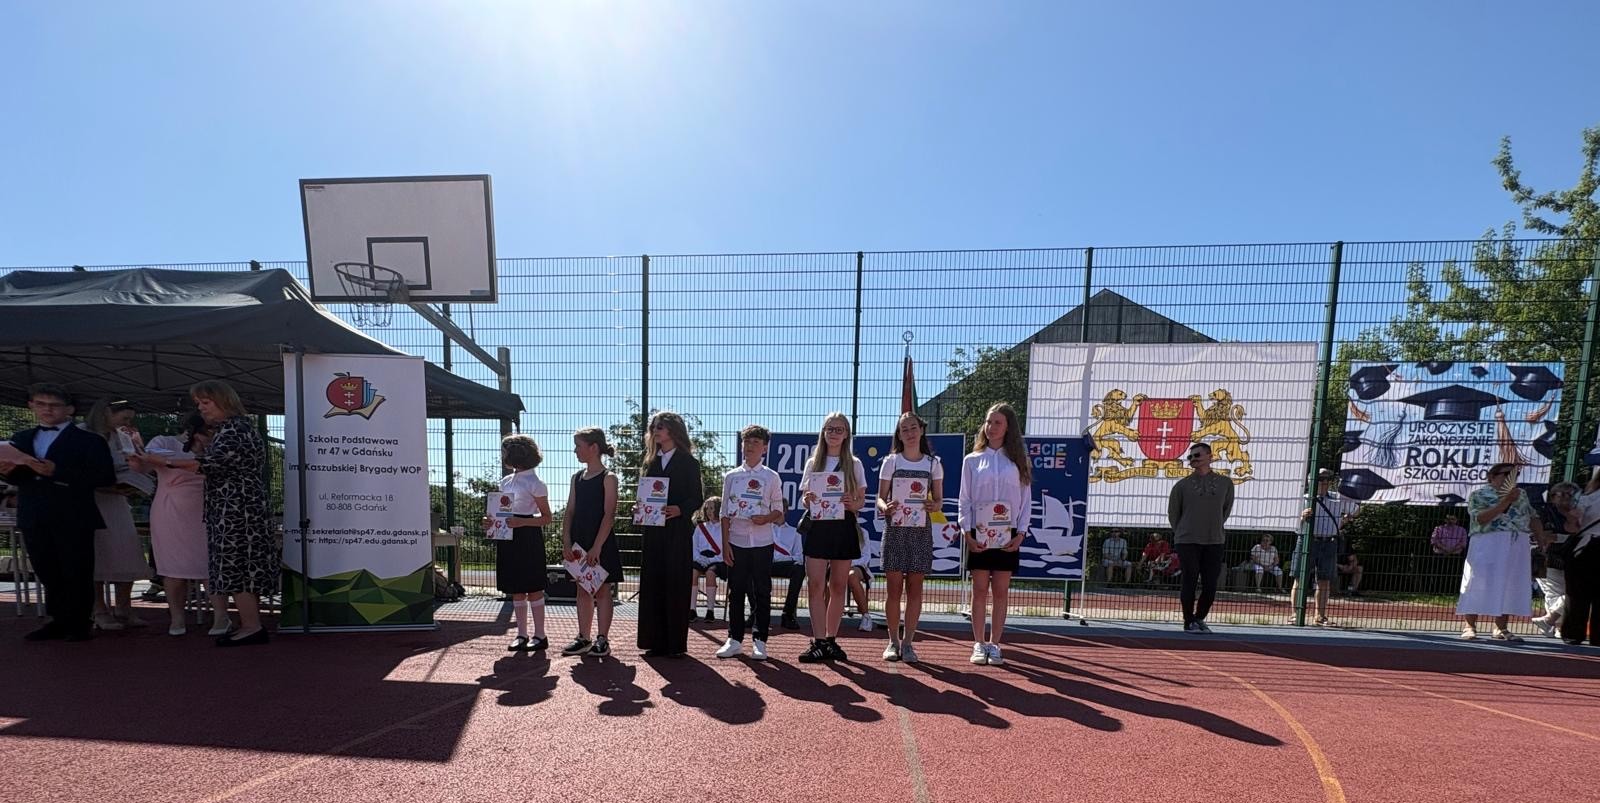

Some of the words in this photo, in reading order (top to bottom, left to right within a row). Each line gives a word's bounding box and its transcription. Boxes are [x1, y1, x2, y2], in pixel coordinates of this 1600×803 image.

[1408, 421, 1495, 434] UROCZYSTE
[308, 434, 340, 444] Szkoła
[341, 435, 399, 446] Podstawowa
[317, 447, 327, 455] nr
[329, 447, 340, 456] 47
[342, 448, 350, 456] w
[351, 447, 394, 457] Gdańsku
[1405, 446, 1481, 469] ROKU
[304, 463, 358, 474] Kaszubskiej
[359, 464, 398, 475] Brygady
[400, 465, 422, 475] WOP
[1403, 467, 1489, 481] SZKOLNEGO
[331, 493, 382, 502] Reformacka
[384, 494, 394, 502] 18
[326, 503, 352, 511] 80-808
[354, 502, 388, 512] Gdańsk
